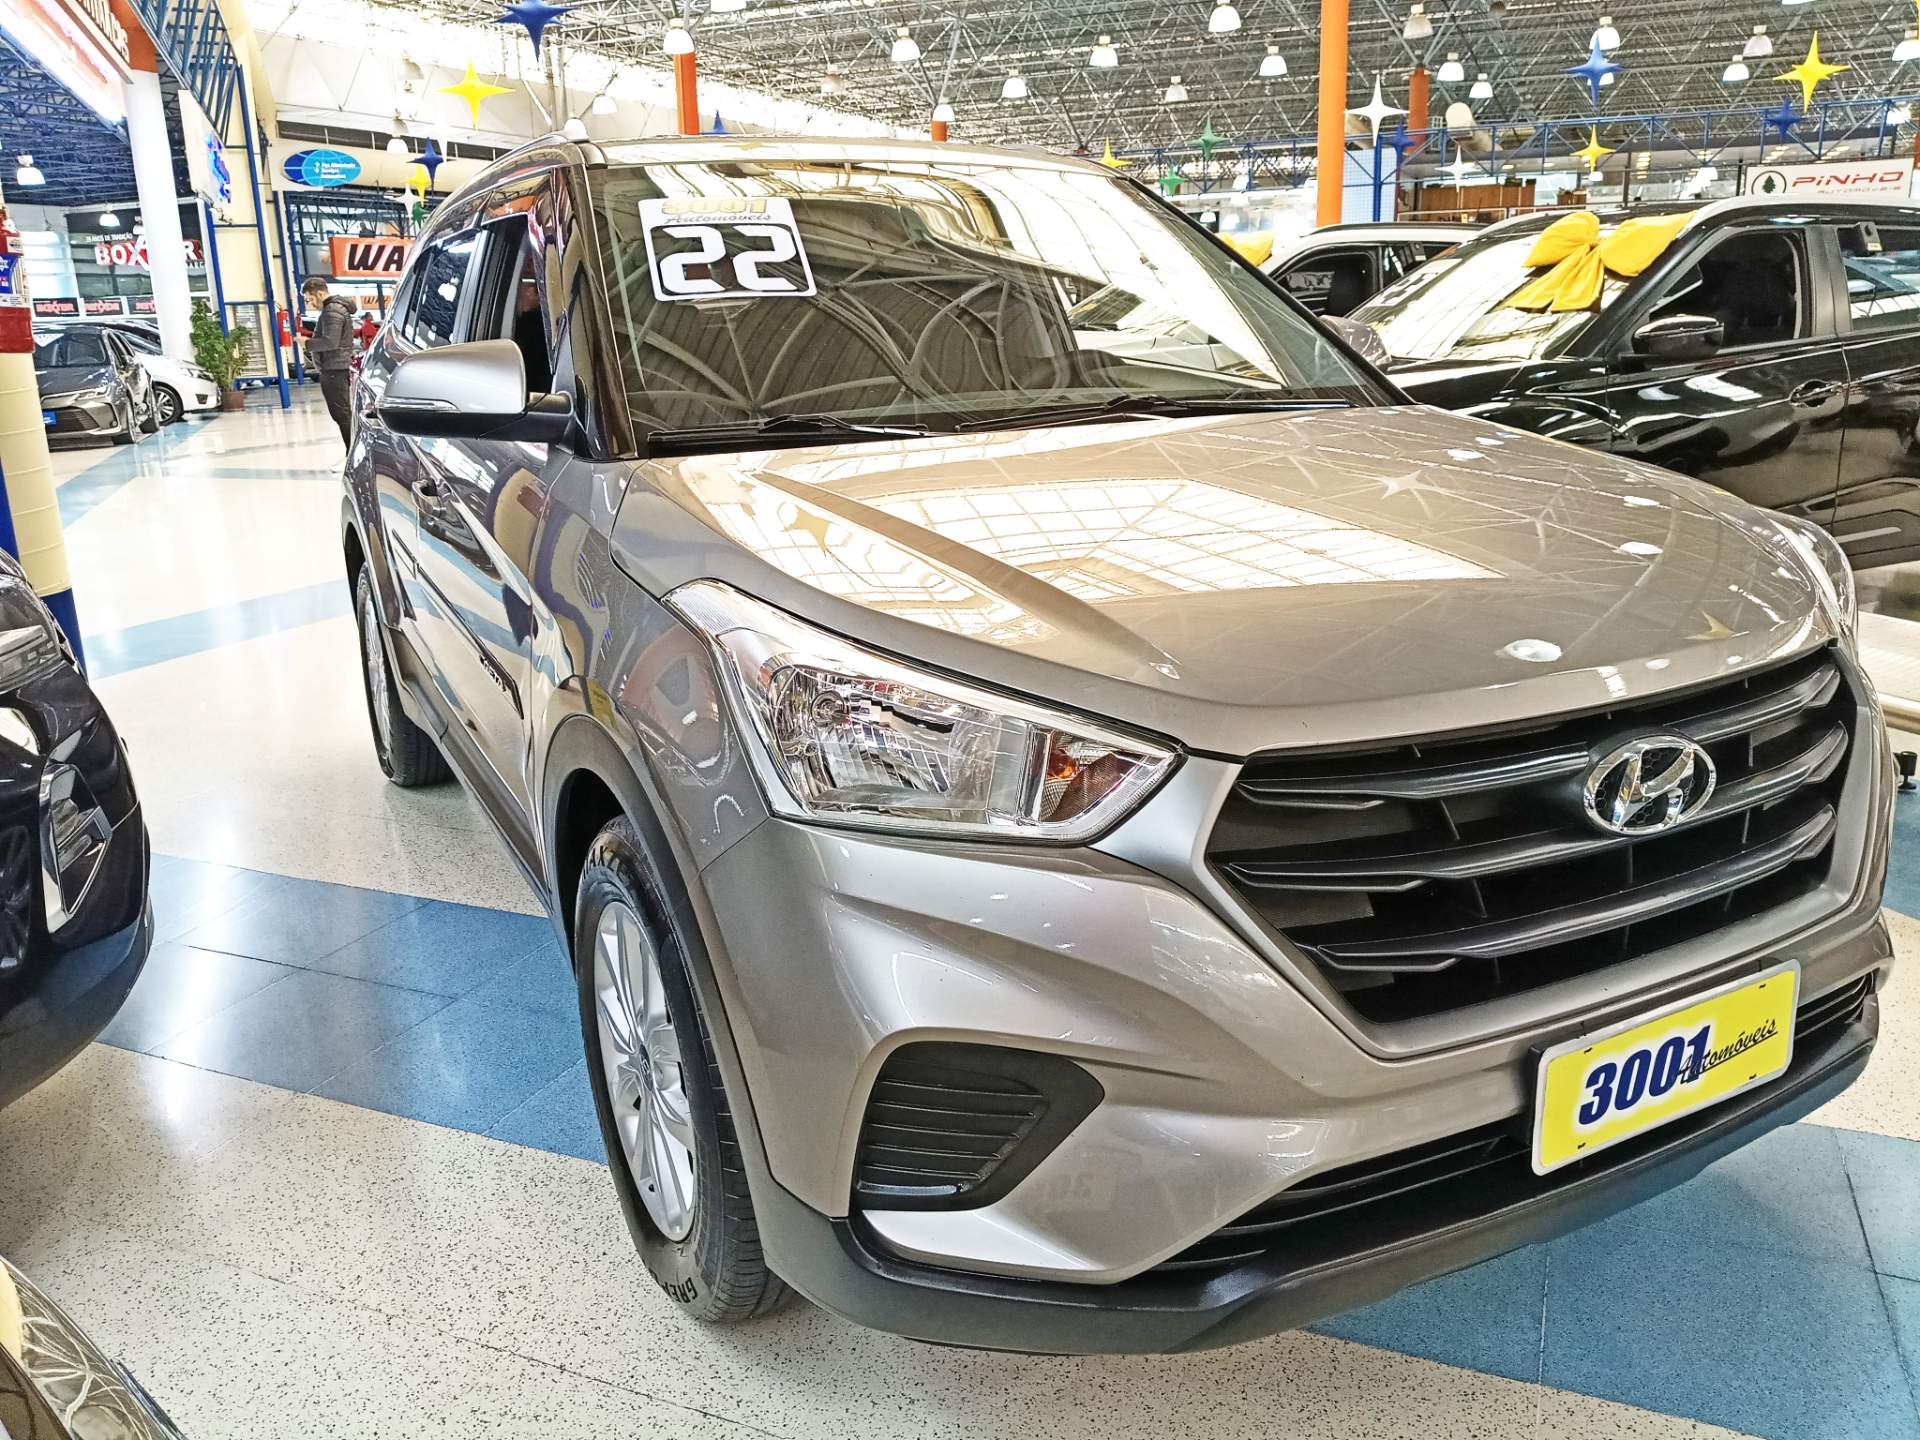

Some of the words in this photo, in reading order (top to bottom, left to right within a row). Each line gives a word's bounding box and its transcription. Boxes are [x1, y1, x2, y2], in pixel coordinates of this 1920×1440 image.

[660, 225, 798, 293] 22
[1578, 1025, 1711, 1125] 3001
[1676, 1018, 1778, 1084] Automóveis
